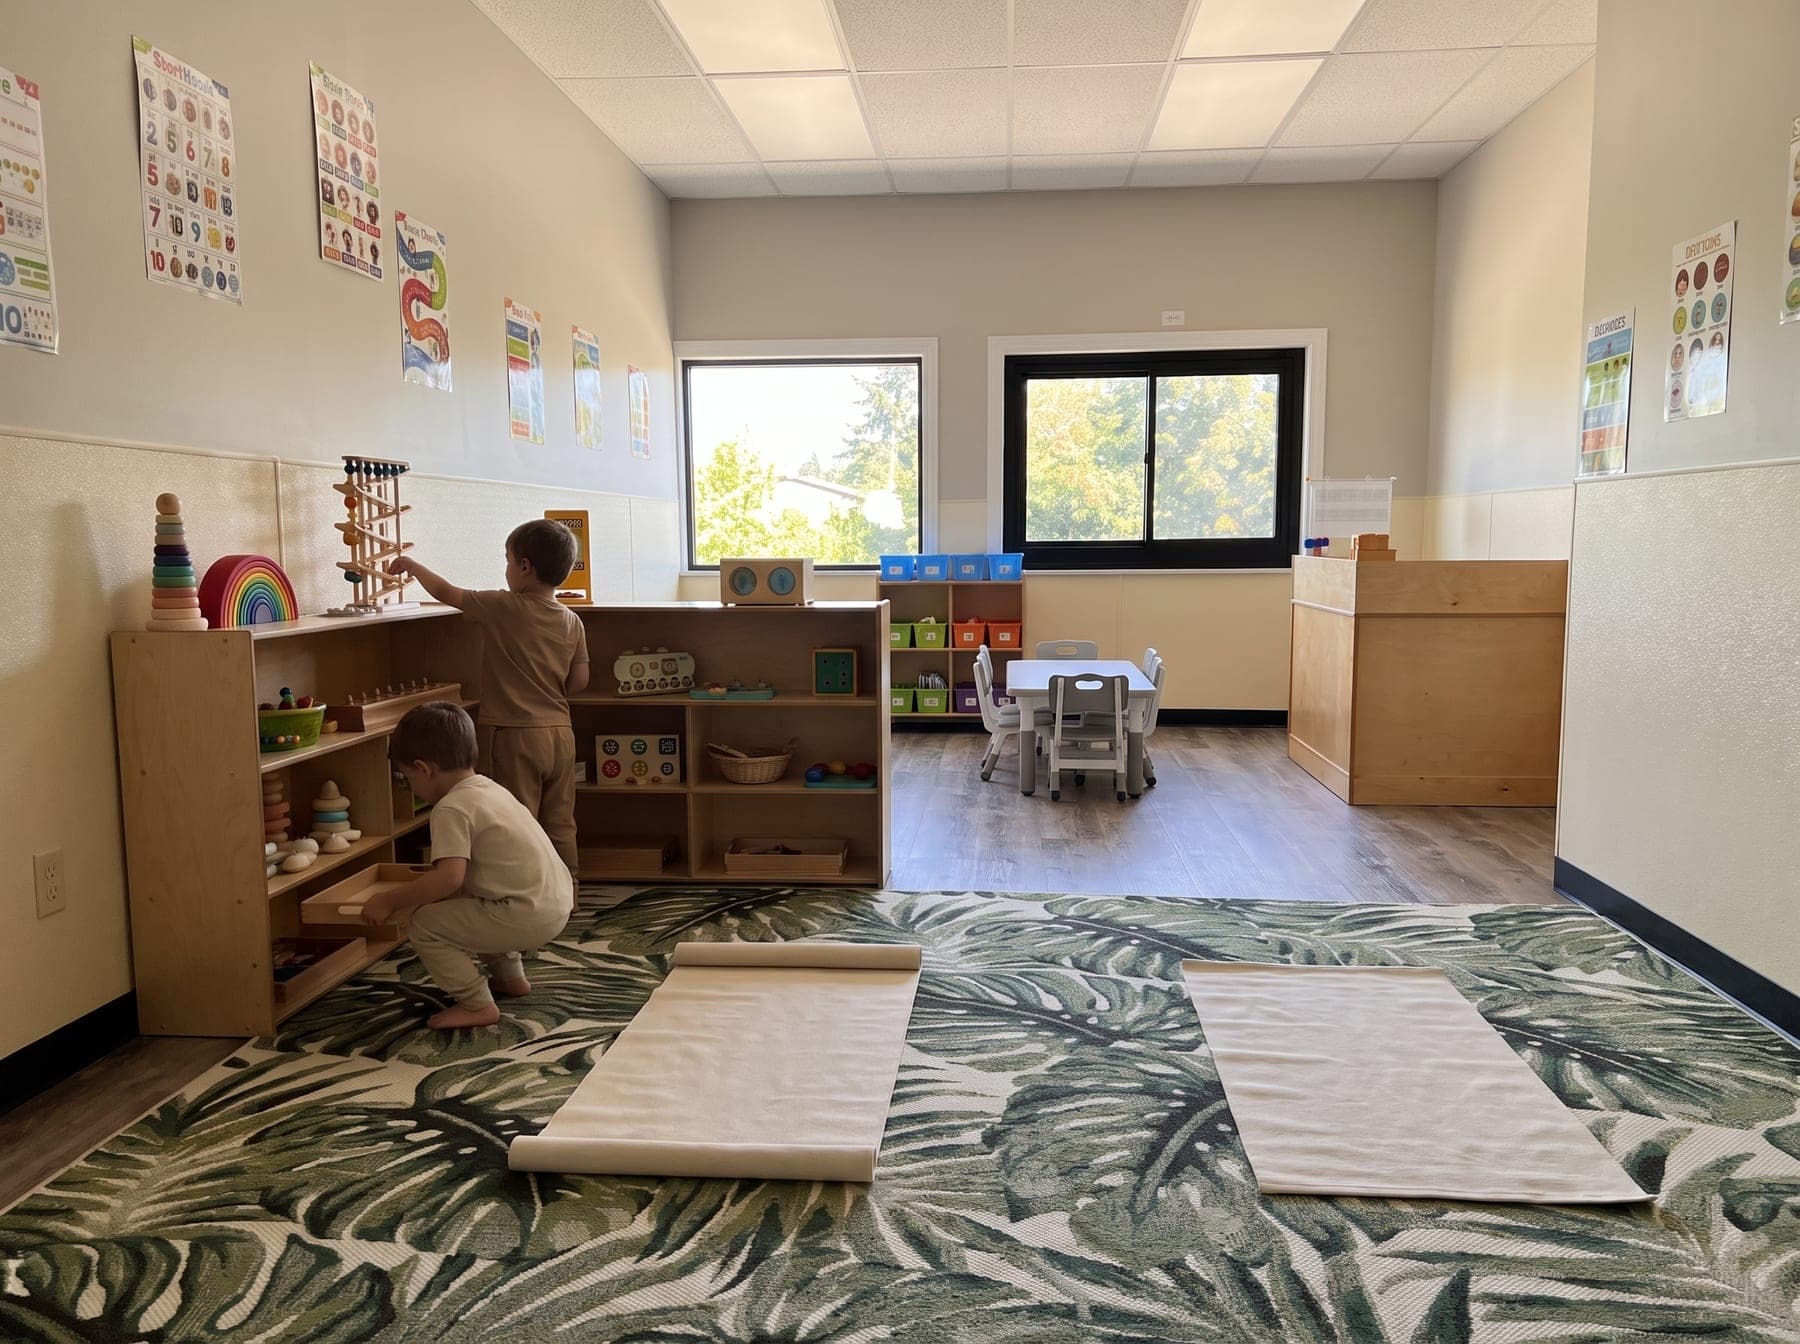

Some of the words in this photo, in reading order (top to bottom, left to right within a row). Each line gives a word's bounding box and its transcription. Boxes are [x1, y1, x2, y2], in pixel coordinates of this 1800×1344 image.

[147, 121, 158, 146] 2
[167, 131, 177, 153] 5
[186, 140, 195, 161] 6
[203, 146, 212, 169] 7
[147, 163, 159, 186] 5
[222, 156, 230, 177] 8
[149, 205, 161, 228] 7
[191, 221, 201, 242] 9
[150, 249, 165, 272] 10
